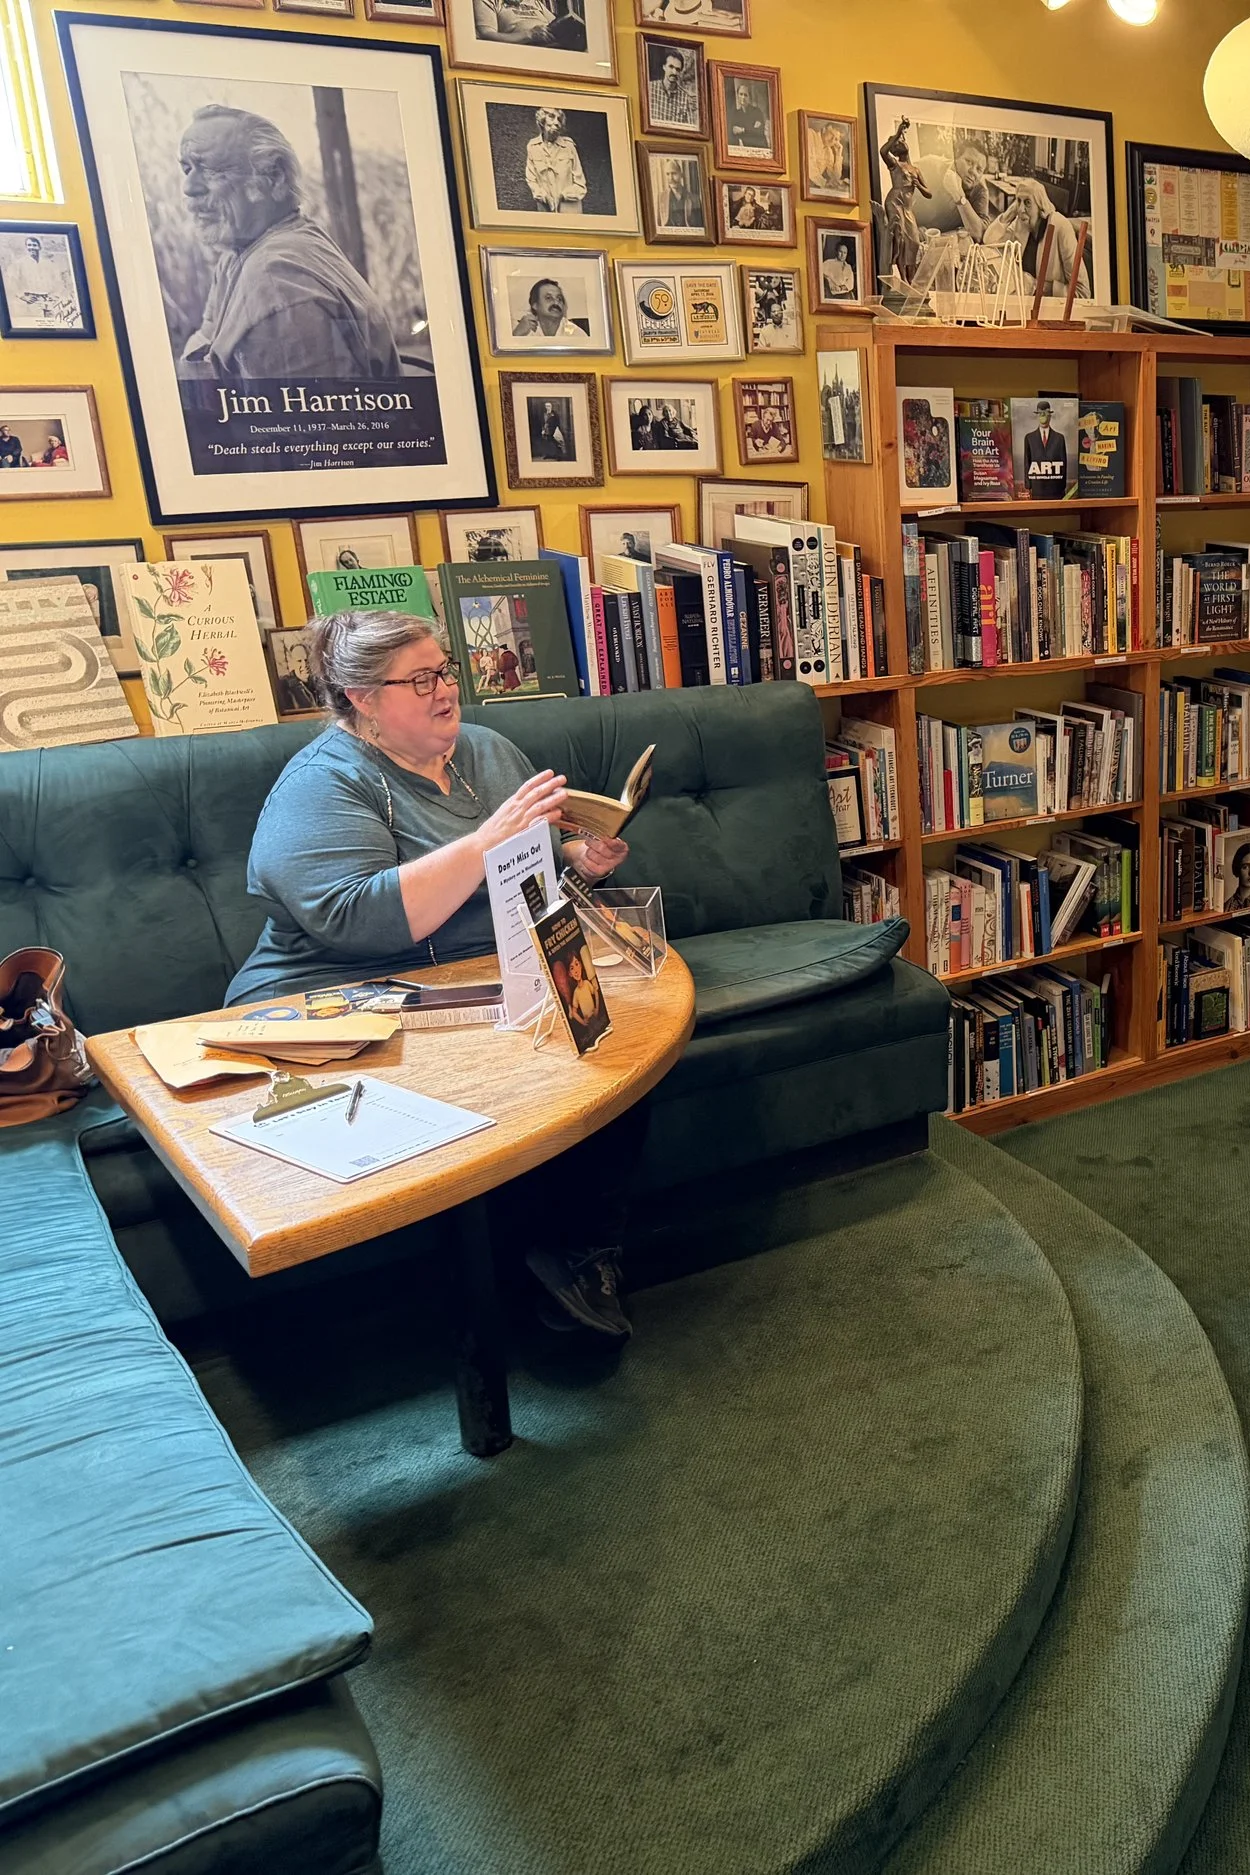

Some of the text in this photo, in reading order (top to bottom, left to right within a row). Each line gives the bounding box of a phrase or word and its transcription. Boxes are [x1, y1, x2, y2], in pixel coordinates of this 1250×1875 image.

[217, 387, 414, 423] Jim Harrison
[250, 425, 291, 433] December
[357, 423, 370, 431] 26,
[371, 422, 390, 430] 2016
[971, 428, 991, 438] Your
[251, 443, 281, 454] steals
[284, 441, 339, 457] everything
[342, 441, 373, 454] except
[376, 441, 394, 450] our
[972, 437, 994, 447] Brain
[985, 446, 999, 455] Art
[324, 459, 354, 468] Harrison
[1028, 461, 1064, 475] ART
[723, 558, 731, 579] PEDRO
[824, 543, 837, 587] JOHN
[455, 572, 550, 585] The Alchemical Feminine
[855, 562, 863, 596] DRAWING
[1212, 571, 1229, 579] THE
[1203, 582, 1237, 592] WORLD
[347, 588, 408, 606] ESTATE
[724, 581, 734, 618] ALMODÓVAR
[927, 568, 939, 645] AFFINITIES
[979, 584, 996, 627] art
[1212, 594, 1236, 602] FIRST
[204, 604, 212, 612] A
[757, 585, 771, 638] VERMEER
[1206, 605, 1234, 615] LIGHT
[187, 615, 235, 626] CURIOUS
[707, 575, 721, 669] GERHARD RICHTER
[190, 629, 238, 641] HERBAL
[828, 602, 841, 664] DERIAN
[594, 602, 602, 628] GREAT
[599, 648, 608, 690] EXPLAINED
[612, 627, 621, 663] OVERLOOKED
[1111, 728, 1121, 784] KANDINSKY
[982, 770, 1033, 790] Turner
[498, 859, 516, 874] Don't
[517, 849, 530, 864] Miss
[530, 843, 541, 855] Out
[544, 935, 556, 950] FRY
[555, 919, 579, 945] CHICKEN
